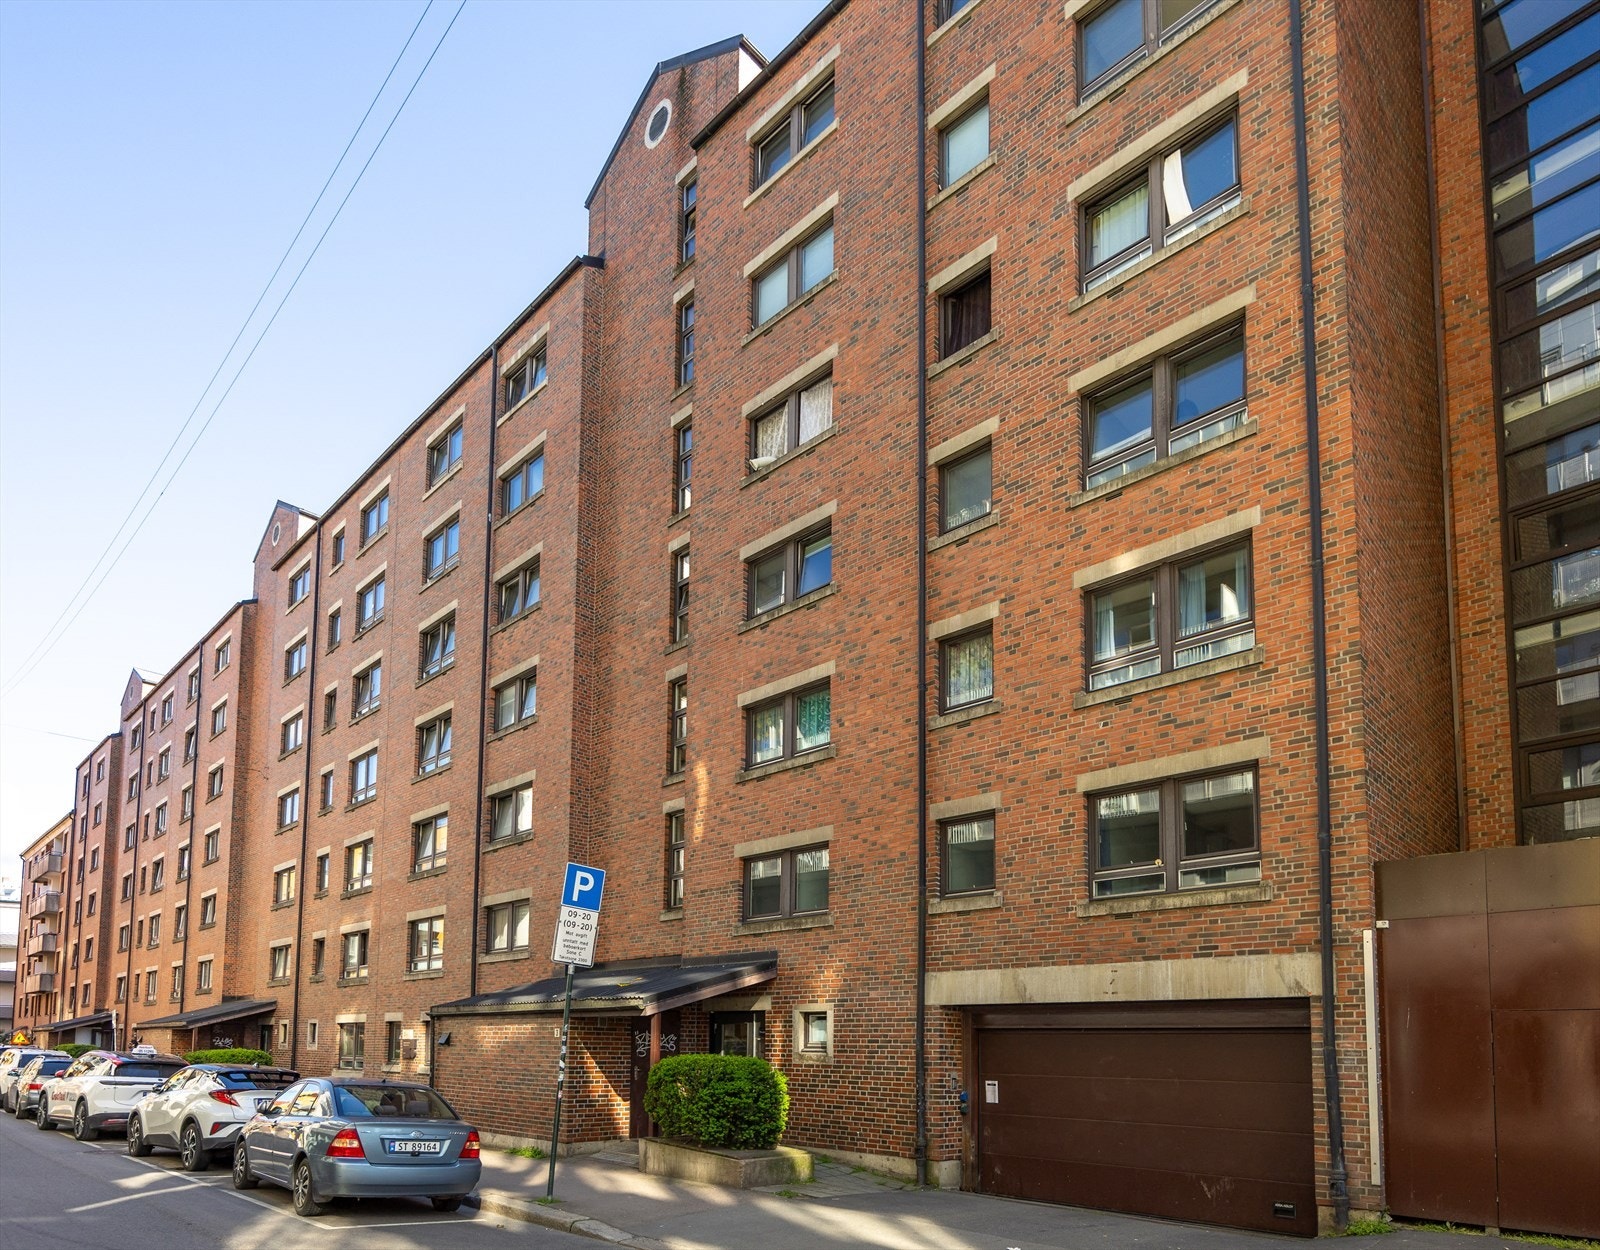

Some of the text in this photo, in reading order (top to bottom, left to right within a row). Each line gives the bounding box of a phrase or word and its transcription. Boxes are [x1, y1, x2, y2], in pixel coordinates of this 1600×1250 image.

[572, 870, 594, 901] P
[398, 1142, 437, 1151] ST 89164
